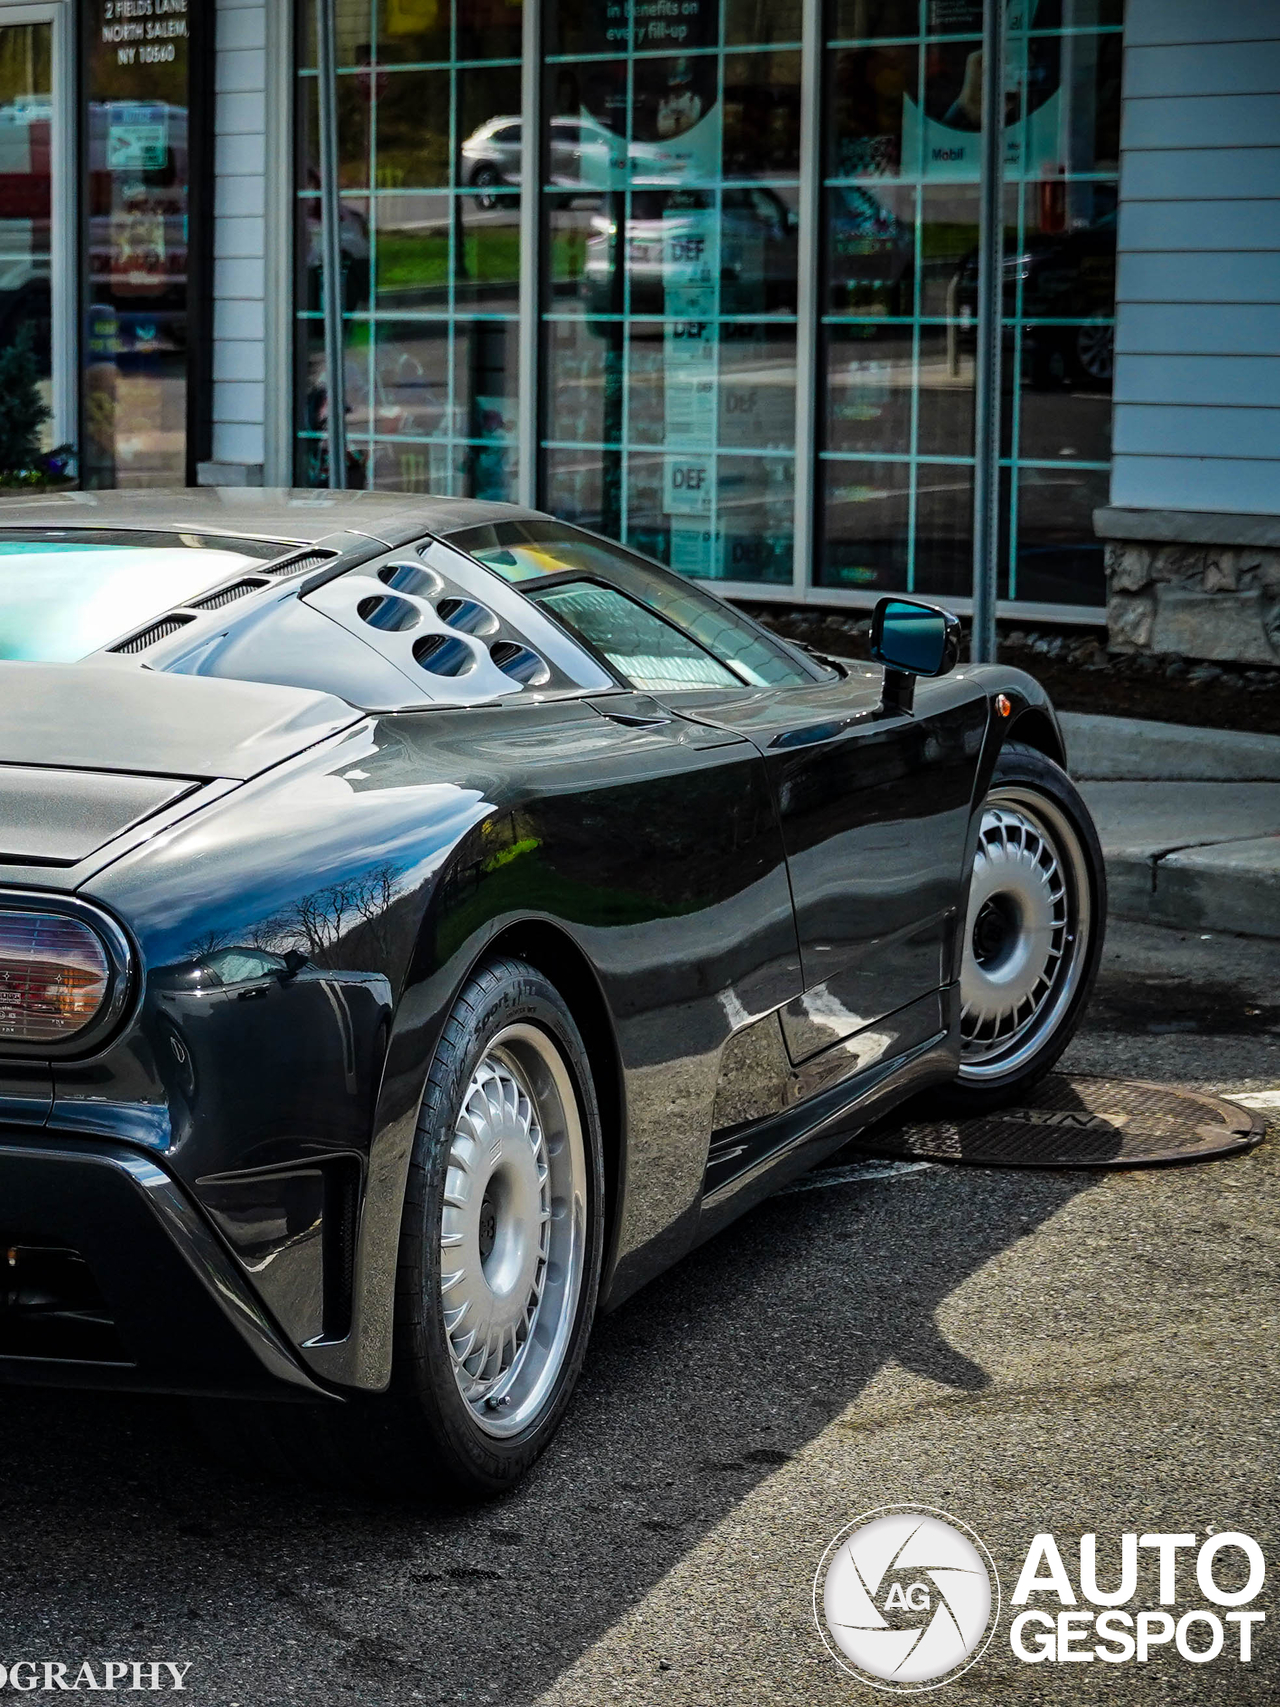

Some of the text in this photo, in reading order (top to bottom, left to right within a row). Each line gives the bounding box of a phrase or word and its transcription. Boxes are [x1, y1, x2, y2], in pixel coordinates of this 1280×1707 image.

[105, 2, 113, 18] 2
[155, 0, 187, 14] LANE
[607, 3, 620, 18] in
[681, 1, 698, 15] on
[102, 22, 144, 42] NORTH
[648, 22, 688, 42] fill-up
[117, 46, 136, 65] NY
[673, 468, 706, 490] DEF
